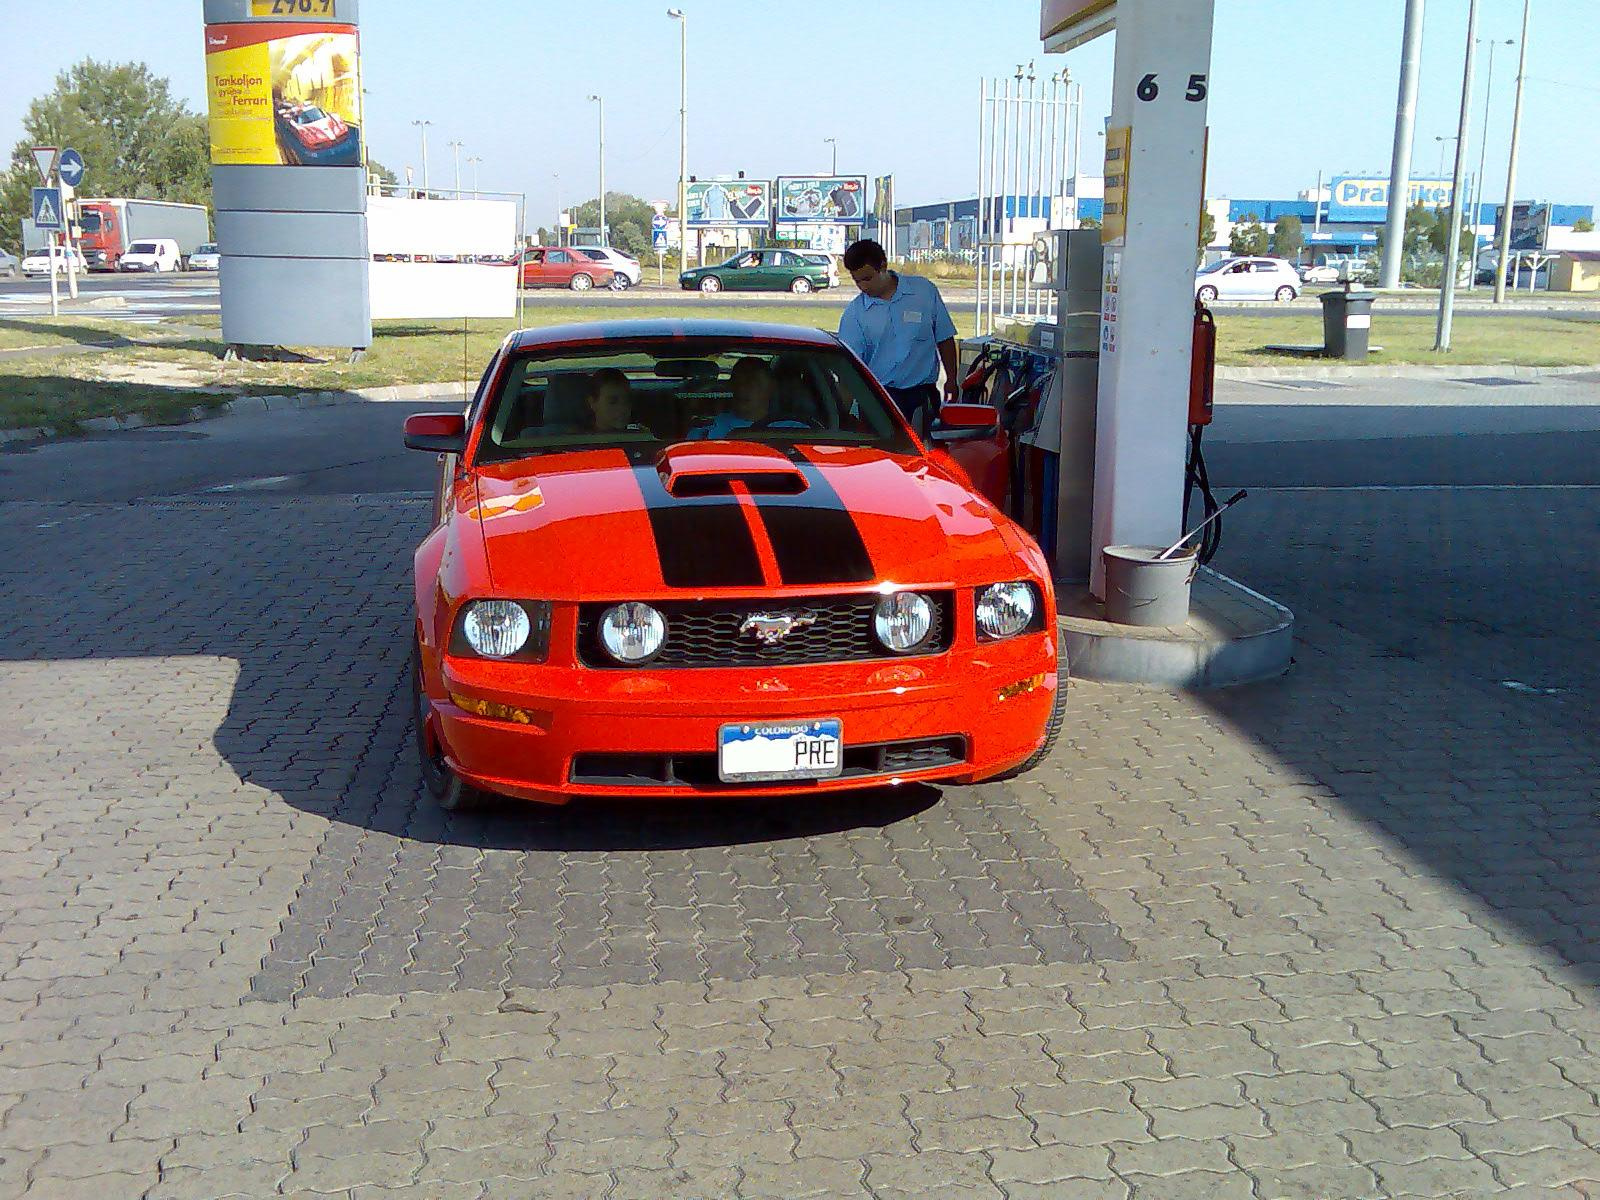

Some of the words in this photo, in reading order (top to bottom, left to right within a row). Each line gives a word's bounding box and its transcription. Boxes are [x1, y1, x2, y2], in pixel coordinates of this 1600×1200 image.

[214, 74, 263, 88] Tankoljon
[1136, 74, 1159, 102] 6
[1185, 74, 1206, 102] 5
[232, 96, 268, 105] Ferrari
[1343, 184, 1454, 202] Praike
[796, 740, 835, 765] PRE
